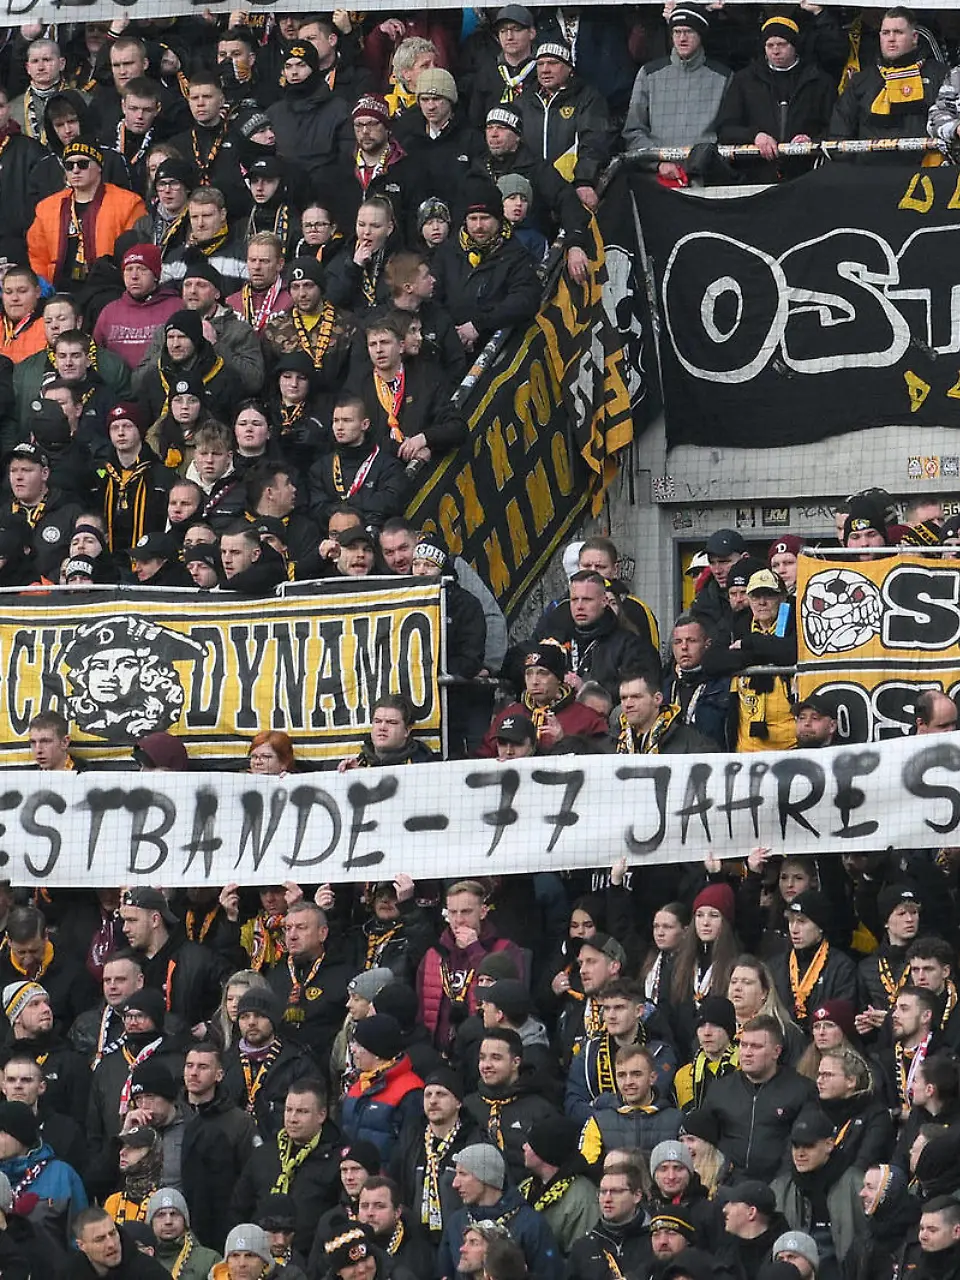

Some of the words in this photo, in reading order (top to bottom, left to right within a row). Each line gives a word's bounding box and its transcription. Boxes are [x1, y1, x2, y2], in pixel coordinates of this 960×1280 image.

[0, 627, 78, 737] CK
[185, 609, 437, 732] DYNAMO
[615, 751, 881, 857] JAHRE
